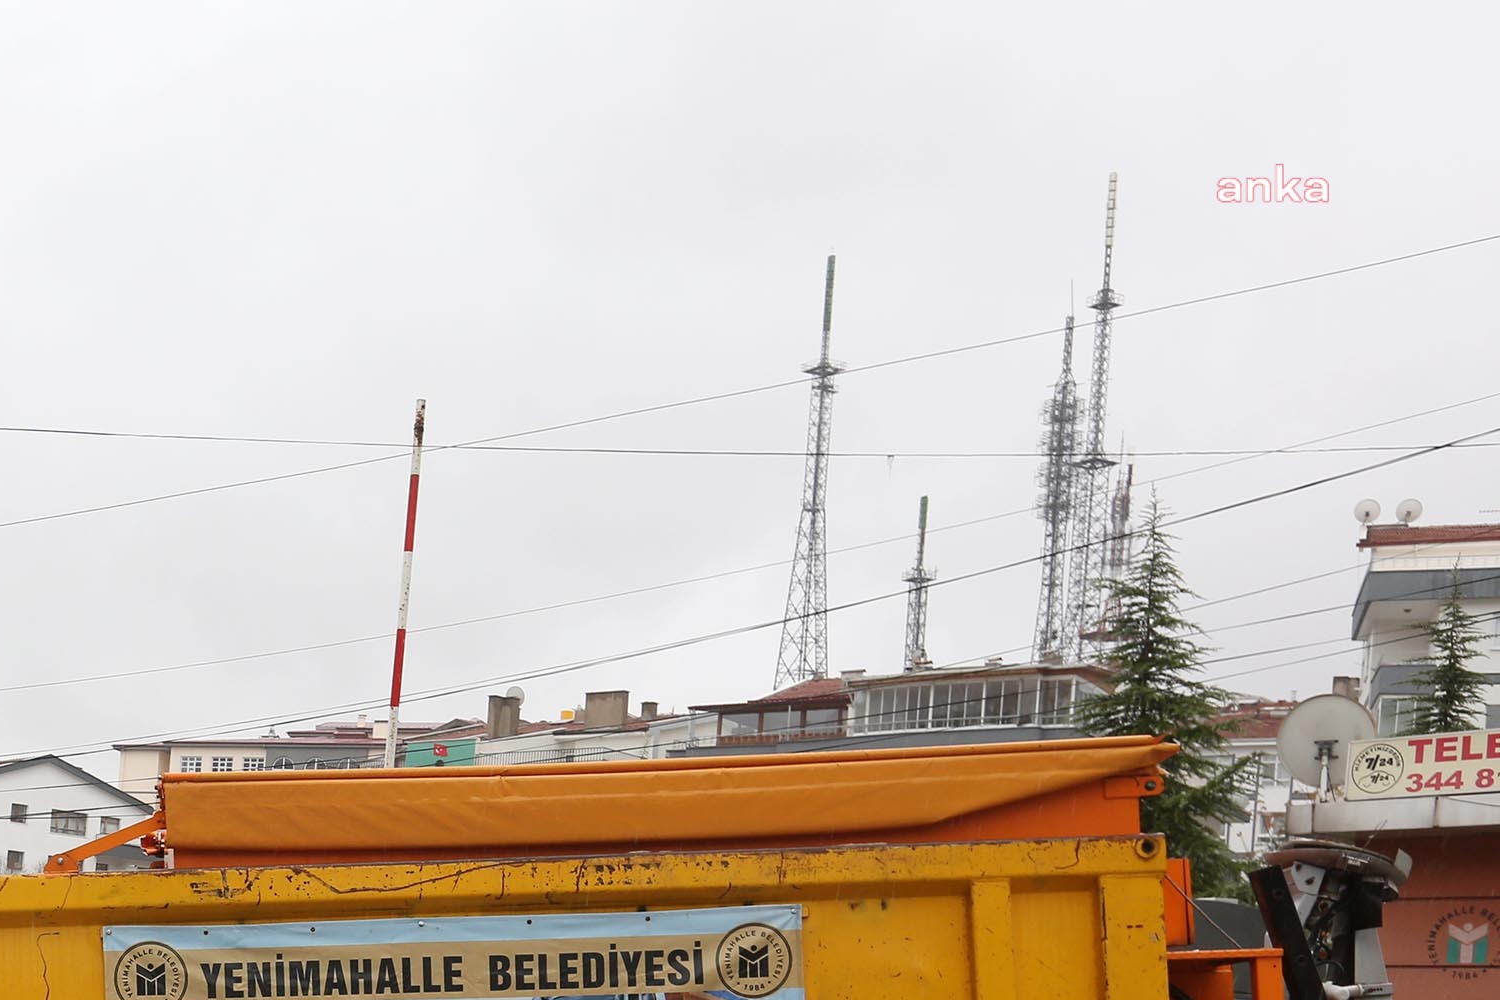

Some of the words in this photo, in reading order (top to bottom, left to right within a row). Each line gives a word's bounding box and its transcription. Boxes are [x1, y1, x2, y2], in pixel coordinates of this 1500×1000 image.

[1365, 754, 1393, 771] 7/24
[1405, 770, 1464, 793] 344
[1475, 768, 1500, 788] 8
[200, 953, 465, 999] YENİMAHALLE
[489, 940, 704, 991] BELEDİYESİ
[725, 930, 756, 980] YENİMAHALLE
[761, 931, 784, 980] BELEDİYESİ
[122, 949, 153, 998] YENİMAHALLE
[157, 950, 181, 999] BELEDİYESİ
[743, 983, 766, 992] 1984
